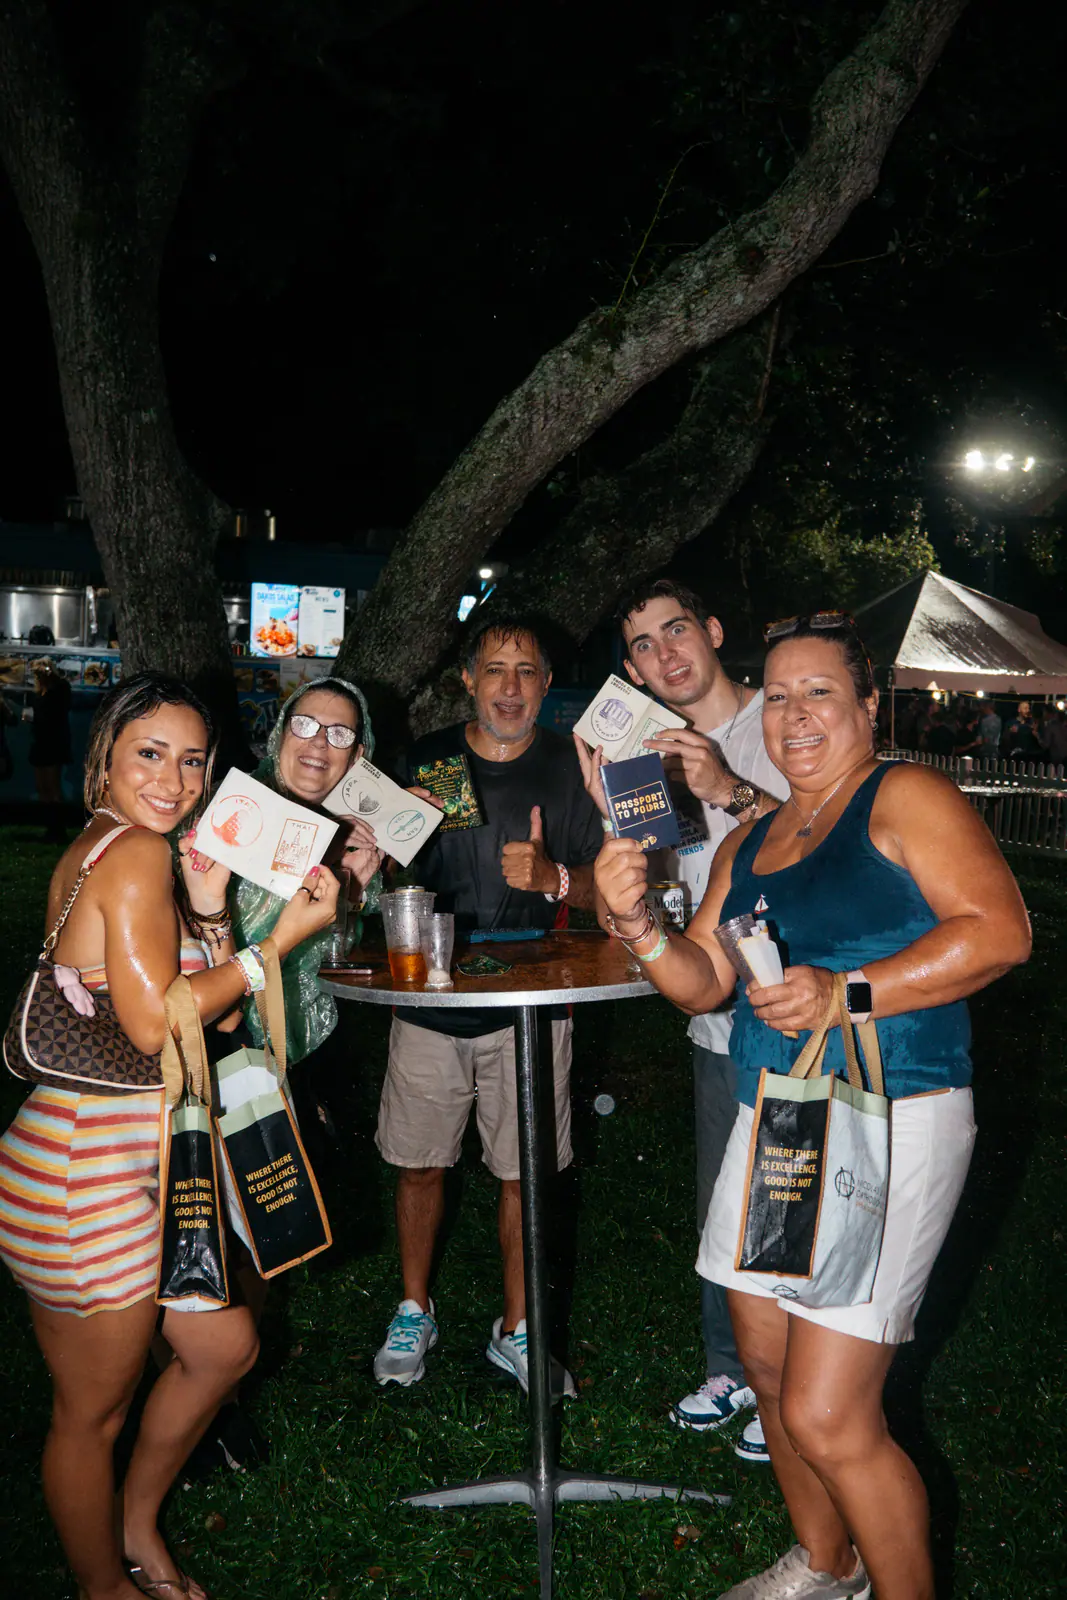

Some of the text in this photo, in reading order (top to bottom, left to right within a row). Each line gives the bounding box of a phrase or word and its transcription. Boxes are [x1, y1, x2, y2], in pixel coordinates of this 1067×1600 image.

[345, 779, 358, 797] JAPA
[614, 791, 663, 812] PASSPORT
[616, 800, 666, 820] TO POURS
[652, 896, 684, 909] Model
[764, 1146, 818, 1160] WHERE THERE
[246, 1153, 293, 1182] WHERE THERE
[761, 1160, 817, 1175] IS EXCELLENCE,
[248, 1165, 298, 1194] IS EXCELLENCE,
[764, 1176, 812, 1188] GOOD IS NOT
[256, 1177, 298, 1204] GOOD IS NOT
[769, 1190, 803, 1201] ENOUGH.
[172, 1195, 179, 1204] IS
[265, 1193, 297, 1213] ENOUGH.
[175, 1206, 194, 1216] GOOD
